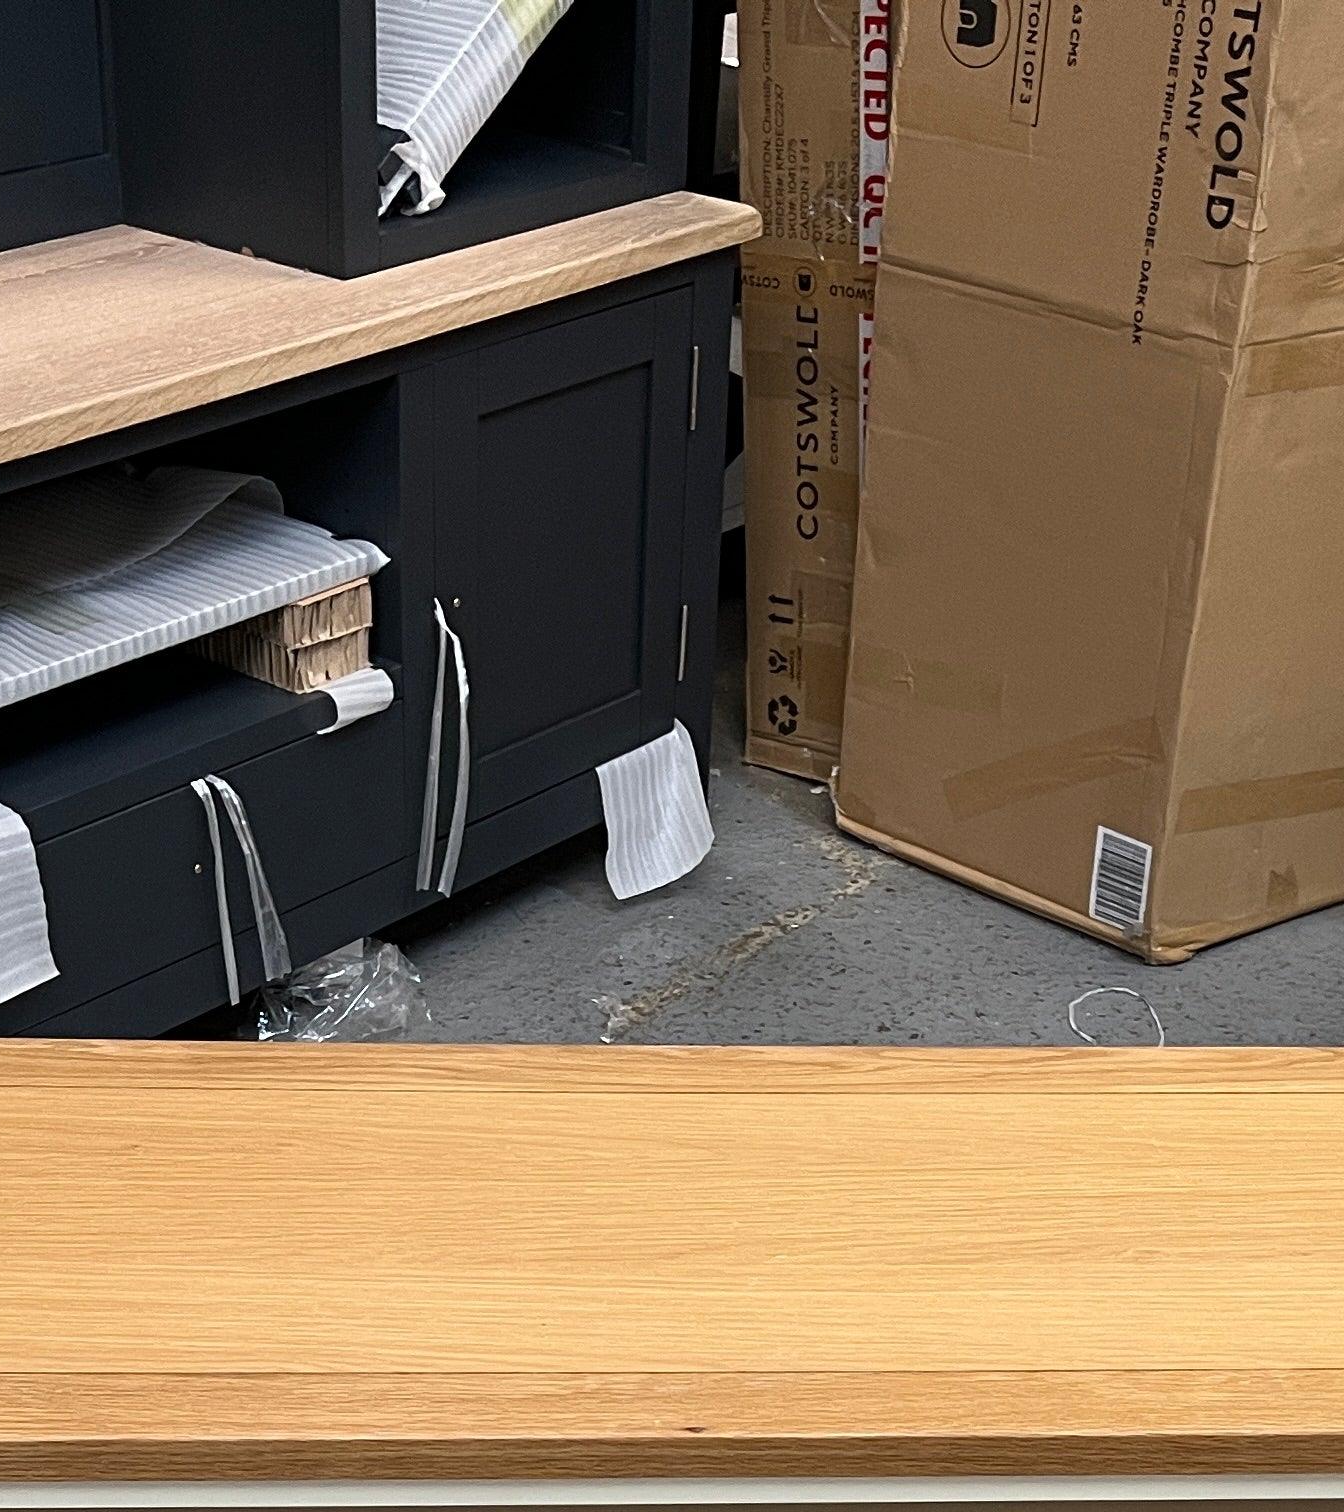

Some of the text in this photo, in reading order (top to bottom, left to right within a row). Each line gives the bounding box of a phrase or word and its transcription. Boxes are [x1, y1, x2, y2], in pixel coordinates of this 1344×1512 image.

[1067, 28, 1081, 67] CMS
[1021, 61, 1035, 91] OF
[1019, 93, 1032, 104] 3
[1159, 81, 1177, 143] TRIPLE
[1136, 259, 1152, 307] DARK
[1131, 310, 1144, 346] OAK
[830, 385, 839, 465] COMPANY
